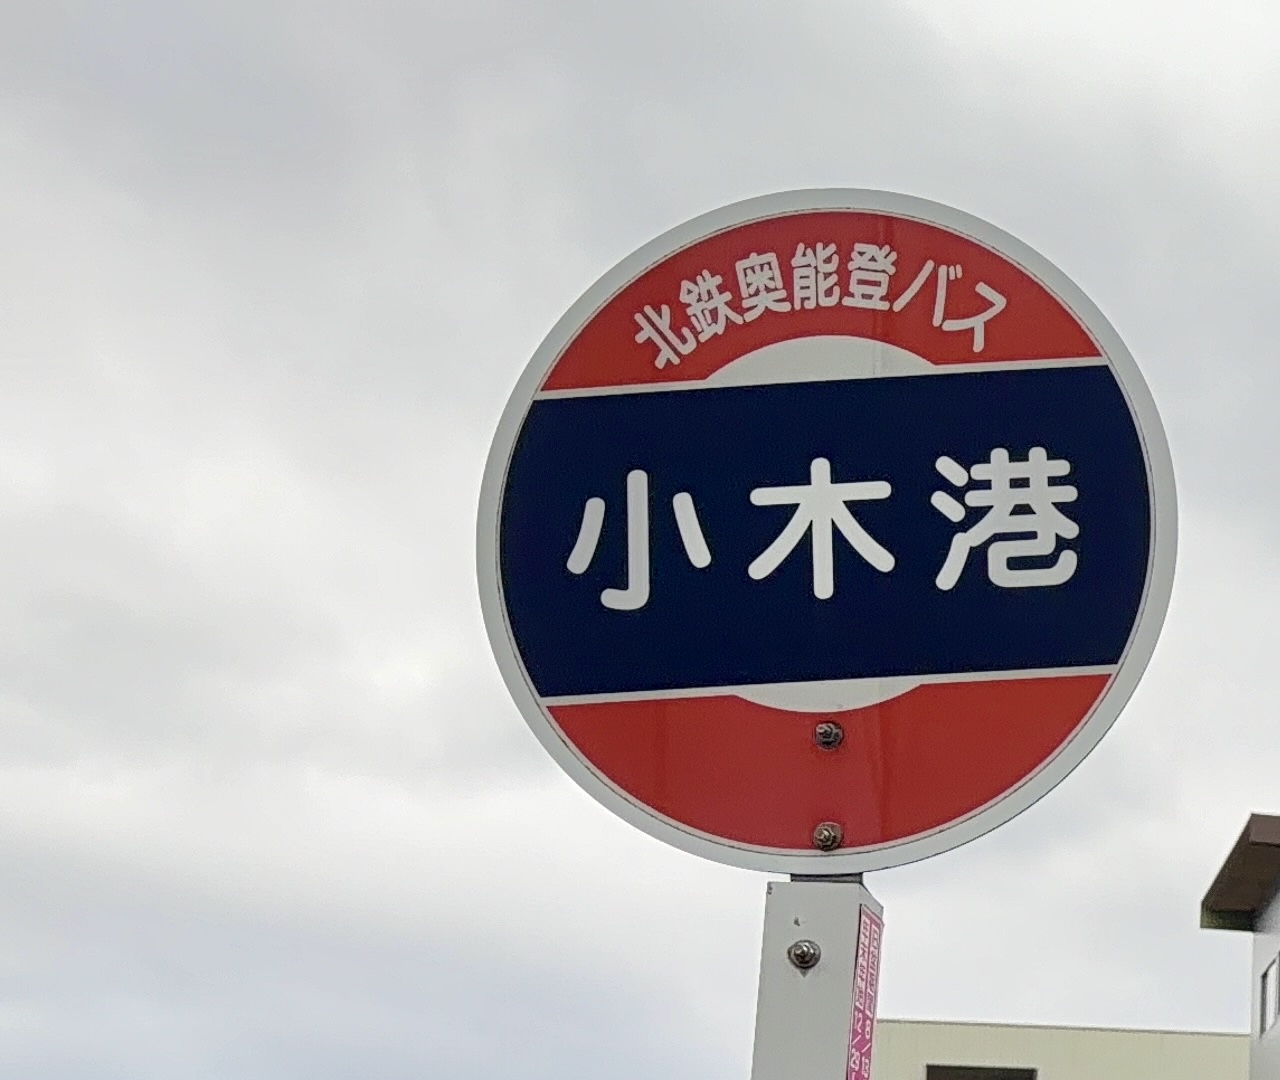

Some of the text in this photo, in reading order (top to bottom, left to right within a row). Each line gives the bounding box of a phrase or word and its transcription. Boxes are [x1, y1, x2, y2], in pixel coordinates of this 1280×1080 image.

[633, 241, 1007, 370] 北鉄奥能登バス
[566, 446, 1080, 611] 小木港
